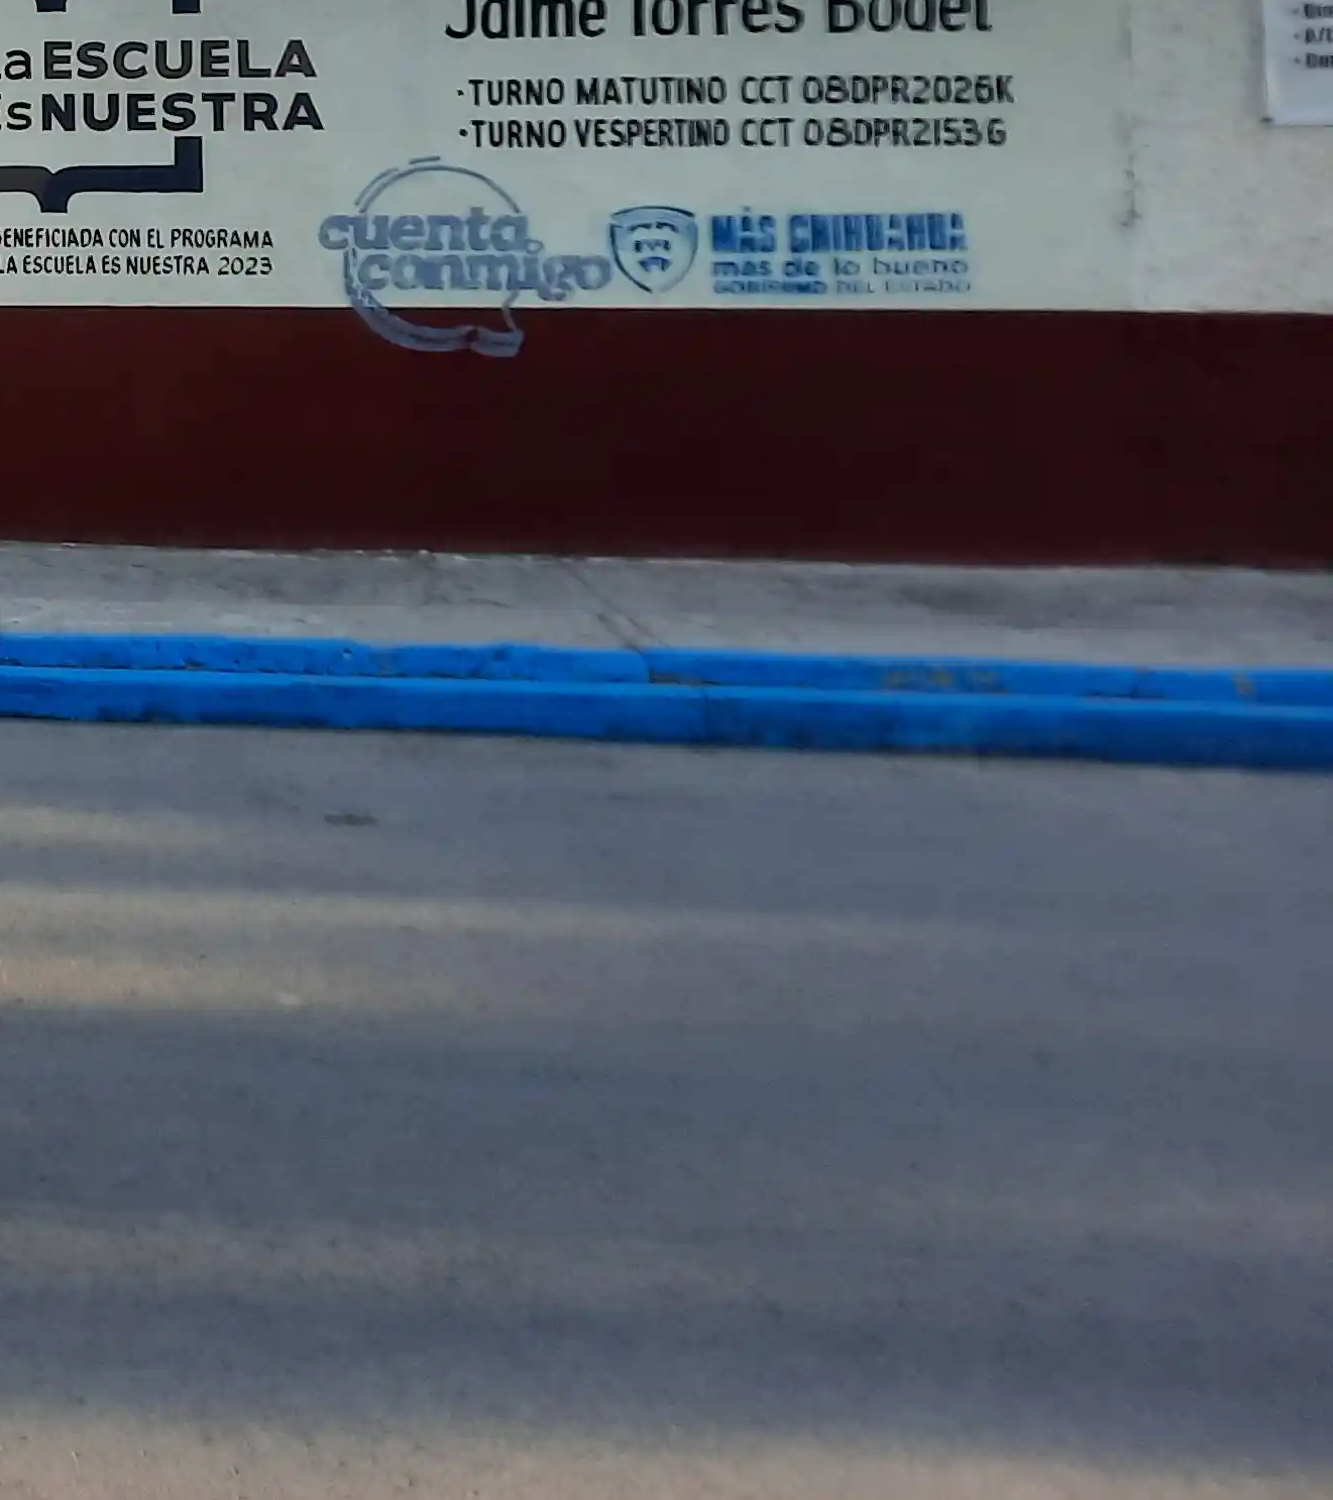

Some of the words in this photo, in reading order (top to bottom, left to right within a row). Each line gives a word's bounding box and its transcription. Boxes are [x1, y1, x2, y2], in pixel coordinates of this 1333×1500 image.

[44, 40, 317, 79] ESCUELA
[577, 77, 726, 105] MATUTINO
[741, 76, 792, 104] CCT
[803, 75, 1013, 104] 08DPR2026K
[42, 93, 324, 131] NUESTRA
[574, 119, 729, 147] VESPERTINO
[741, 118, 794, 146] CCT
[804, 118, 1005, 146] 08DPR2153G
[109, 229, 140, 247] CON
[148, 229, 164, 248] EL
[171, 229, 273, 248] PROGRAMA
[317, 206, 531, 250] cuenta
[23, 255, 96, 274] ESCUELA
[102, 255, 121, 274] ES
[127, 255, 209, 275] NUESTRA
[218, 257, 272, 275] 2023
[355, 253, 613, 301] conmigo
[872, 257, 969, 275] bueno
